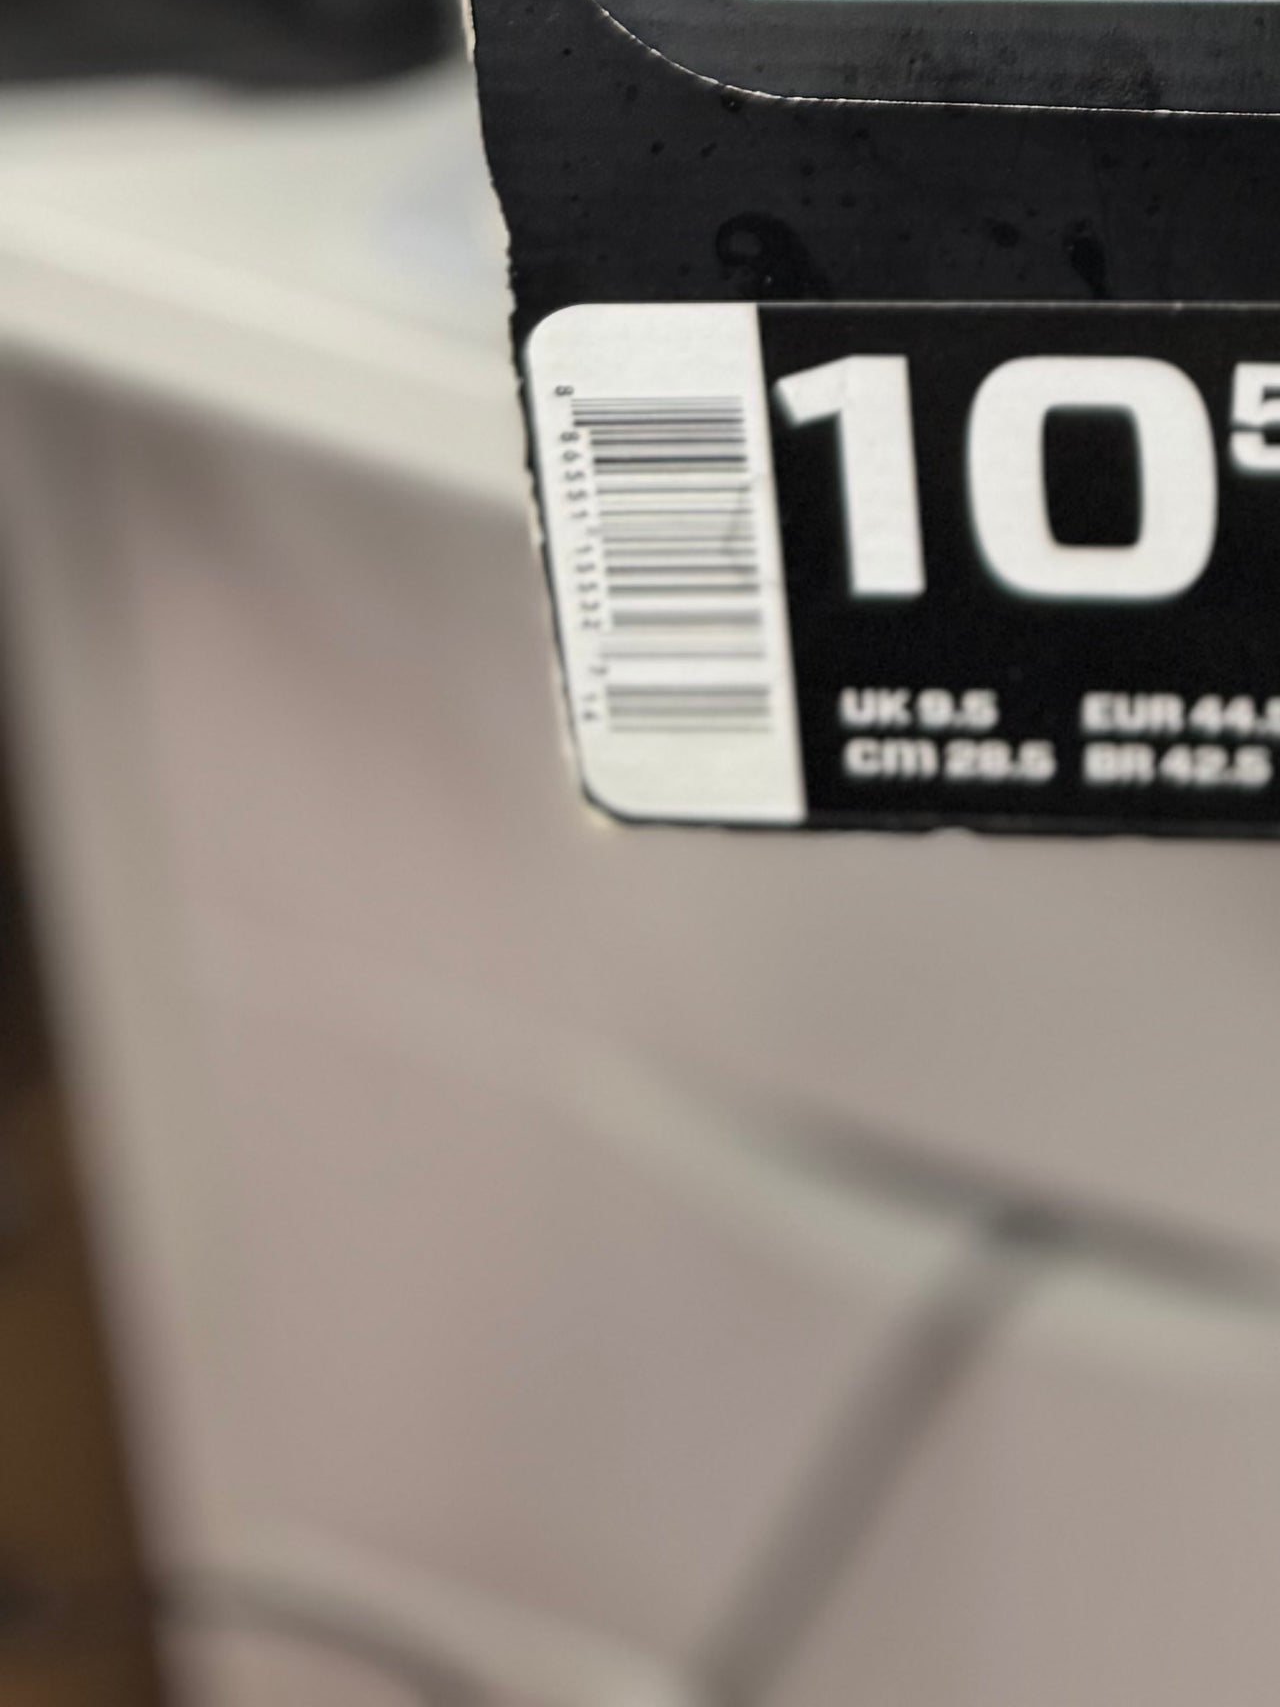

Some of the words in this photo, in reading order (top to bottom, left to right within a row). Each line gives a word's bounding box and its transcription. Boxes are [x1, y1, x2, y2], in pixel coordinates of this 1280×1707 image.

[839, 687, 912, 731] UK
[916, 688, 1000, 732] 9.5
[1081, 691, 1185, 737] EUR
[1083, 741, 1156, 785] BR
[1159, 744, 1273, 787] 42.5
